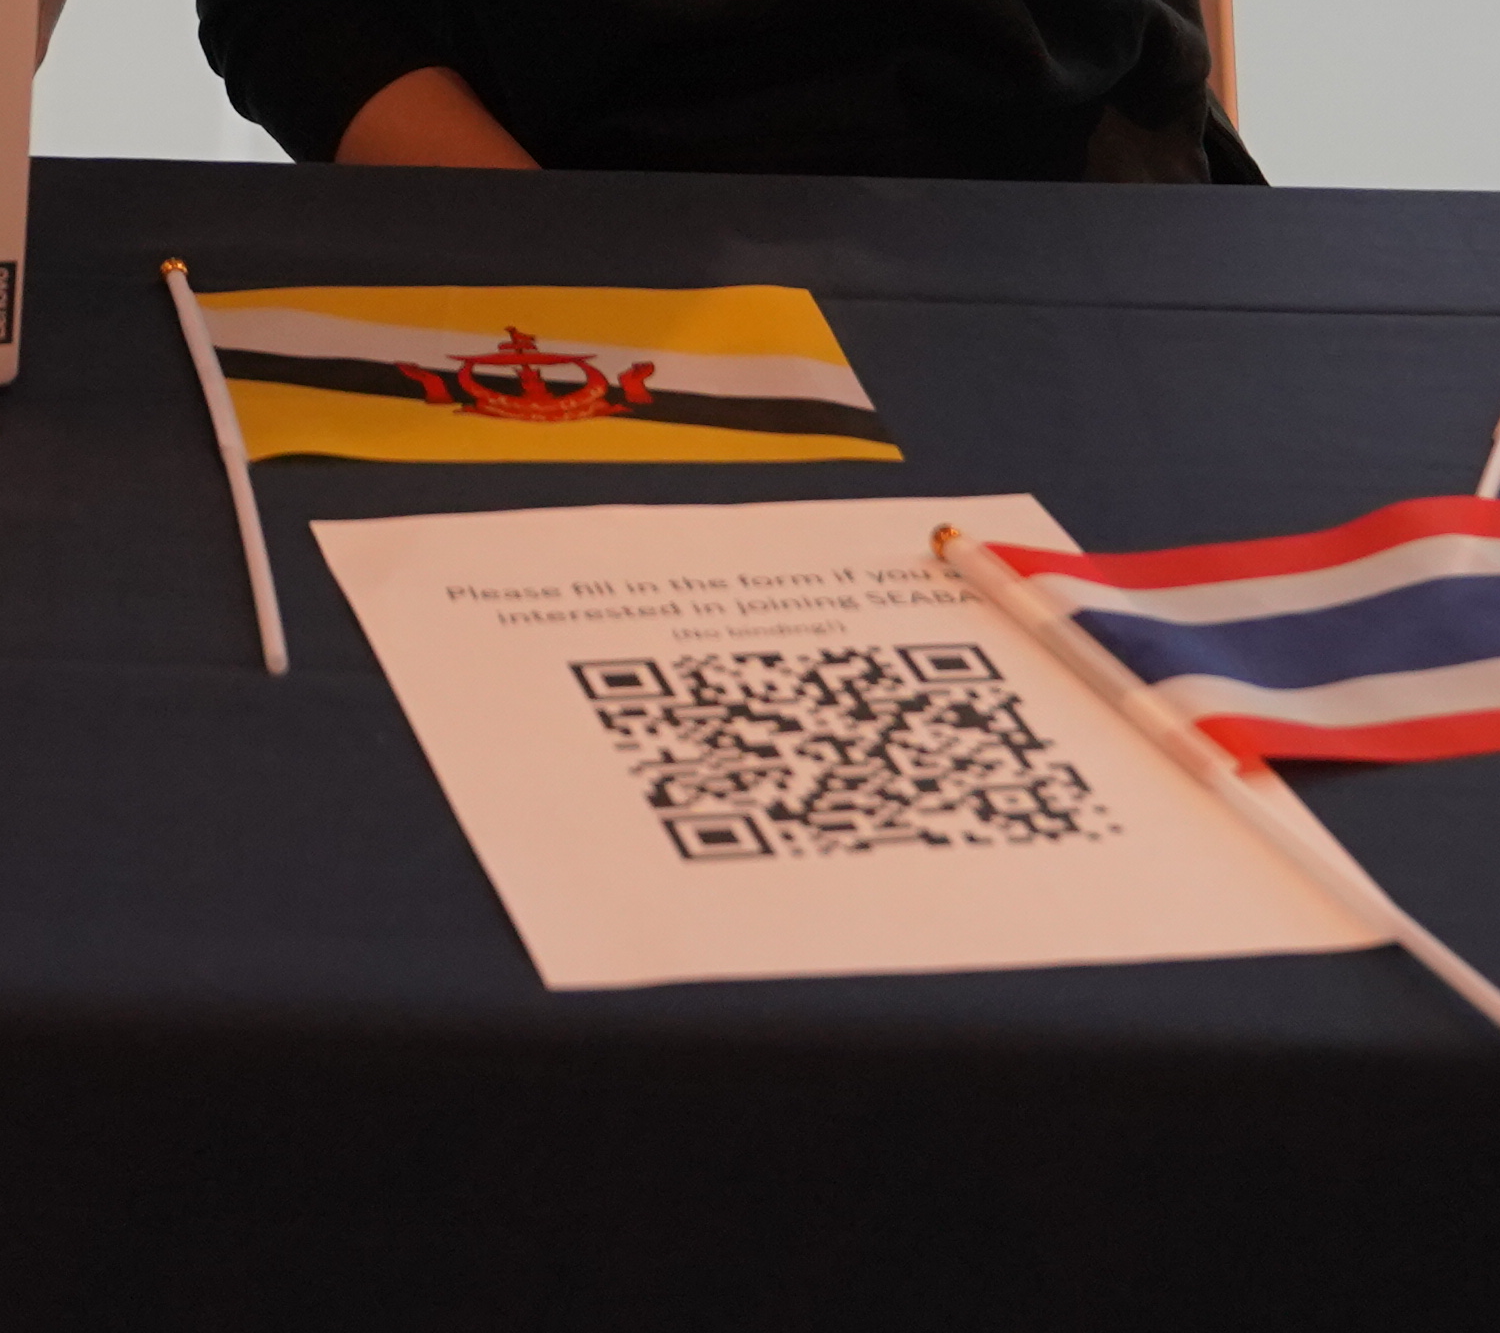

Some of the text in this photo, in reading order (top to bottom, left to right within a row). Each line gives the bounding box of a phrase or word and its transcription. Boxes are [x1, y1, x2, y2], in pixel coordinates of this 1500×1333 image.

[447, 585, 562, 601] Please
[572, 581, 616, 596] fill
[625, 580, 659, 594] in
[668, 576, 728, 591] the
[736, 573, 823, 588] form
[865, 568, 931, 584] you
[497, 601, 682, 625] interested
[690, 598, 726, 613] in
[735, 594, 859, 615] joining
